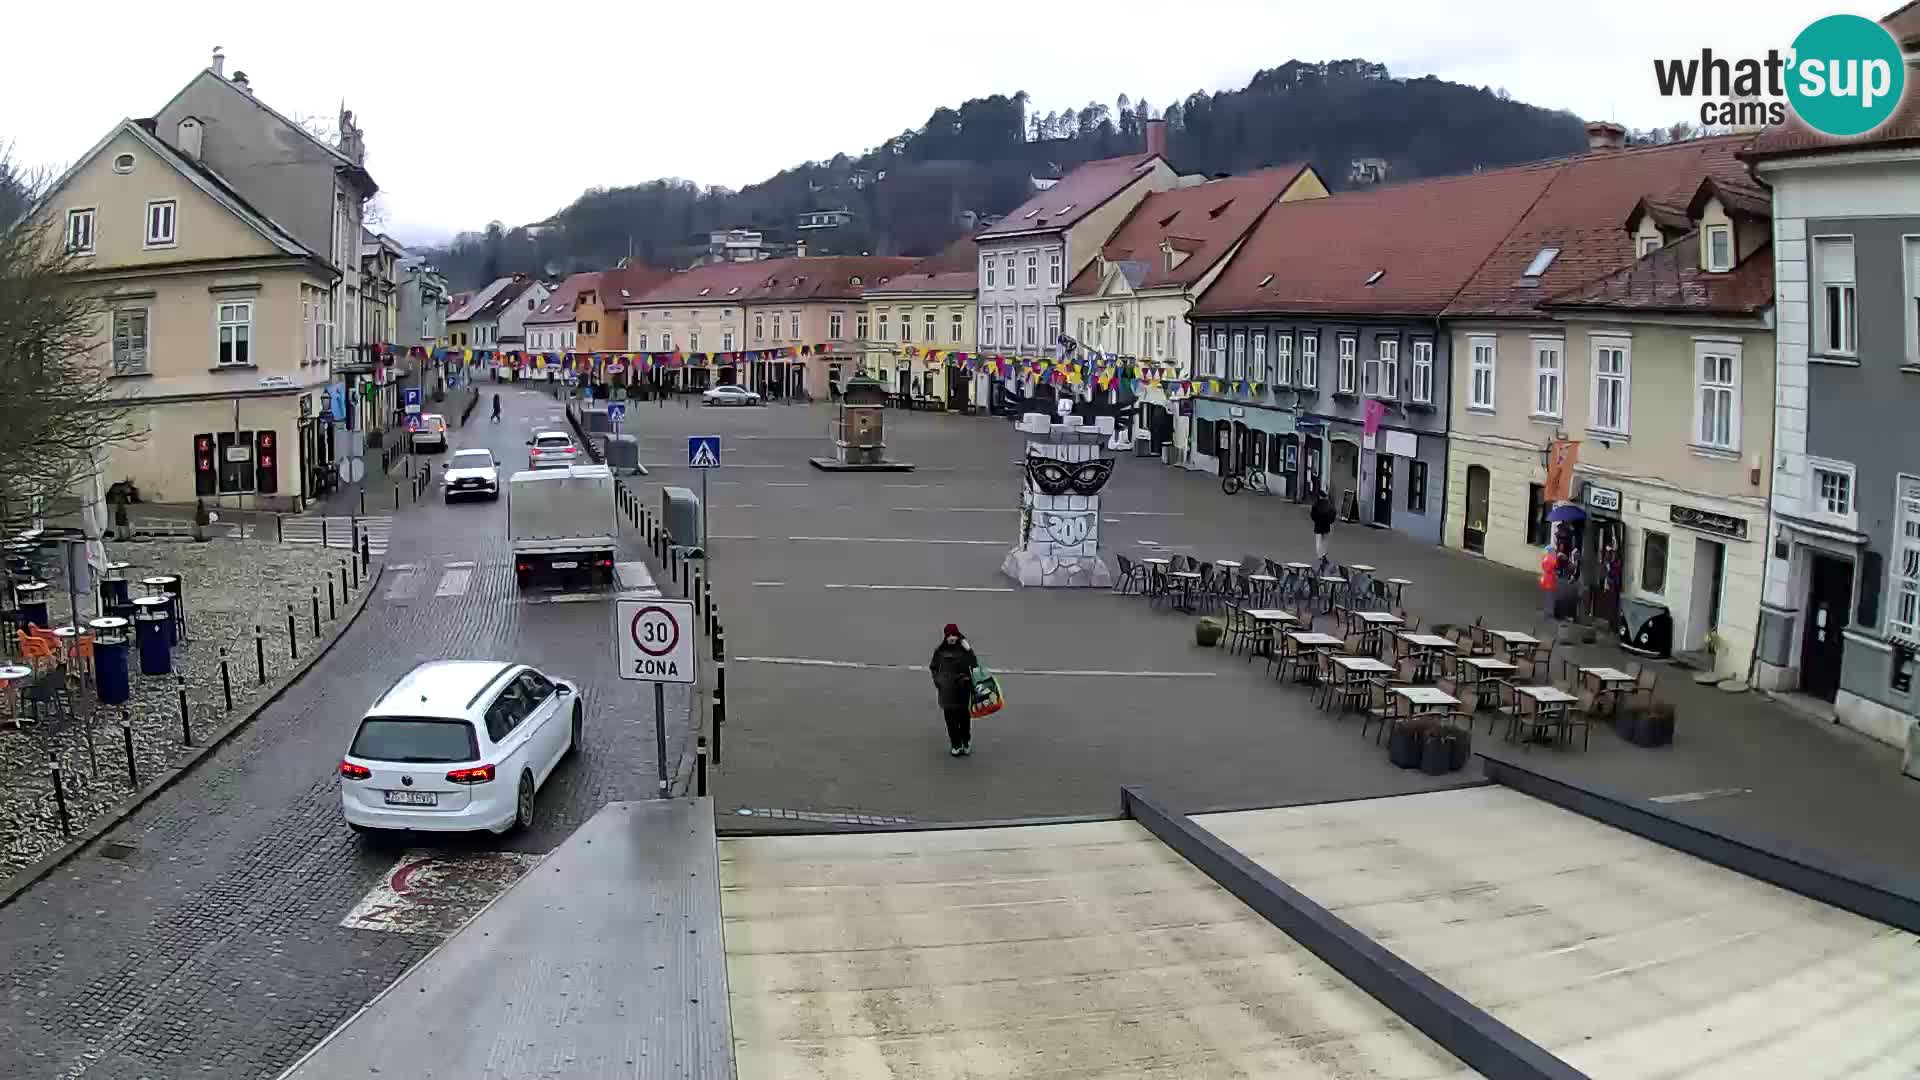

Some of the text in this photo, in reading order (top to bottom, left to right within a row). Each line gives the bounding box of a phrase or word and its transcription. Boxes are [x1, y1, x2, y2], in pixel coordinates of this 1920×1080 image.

[408, 391, 417, 403] P
[1048, 516, 1088, 545] 200
[644, 622, 668, 643] 30
[634, 659, 679, 677] ZONA
